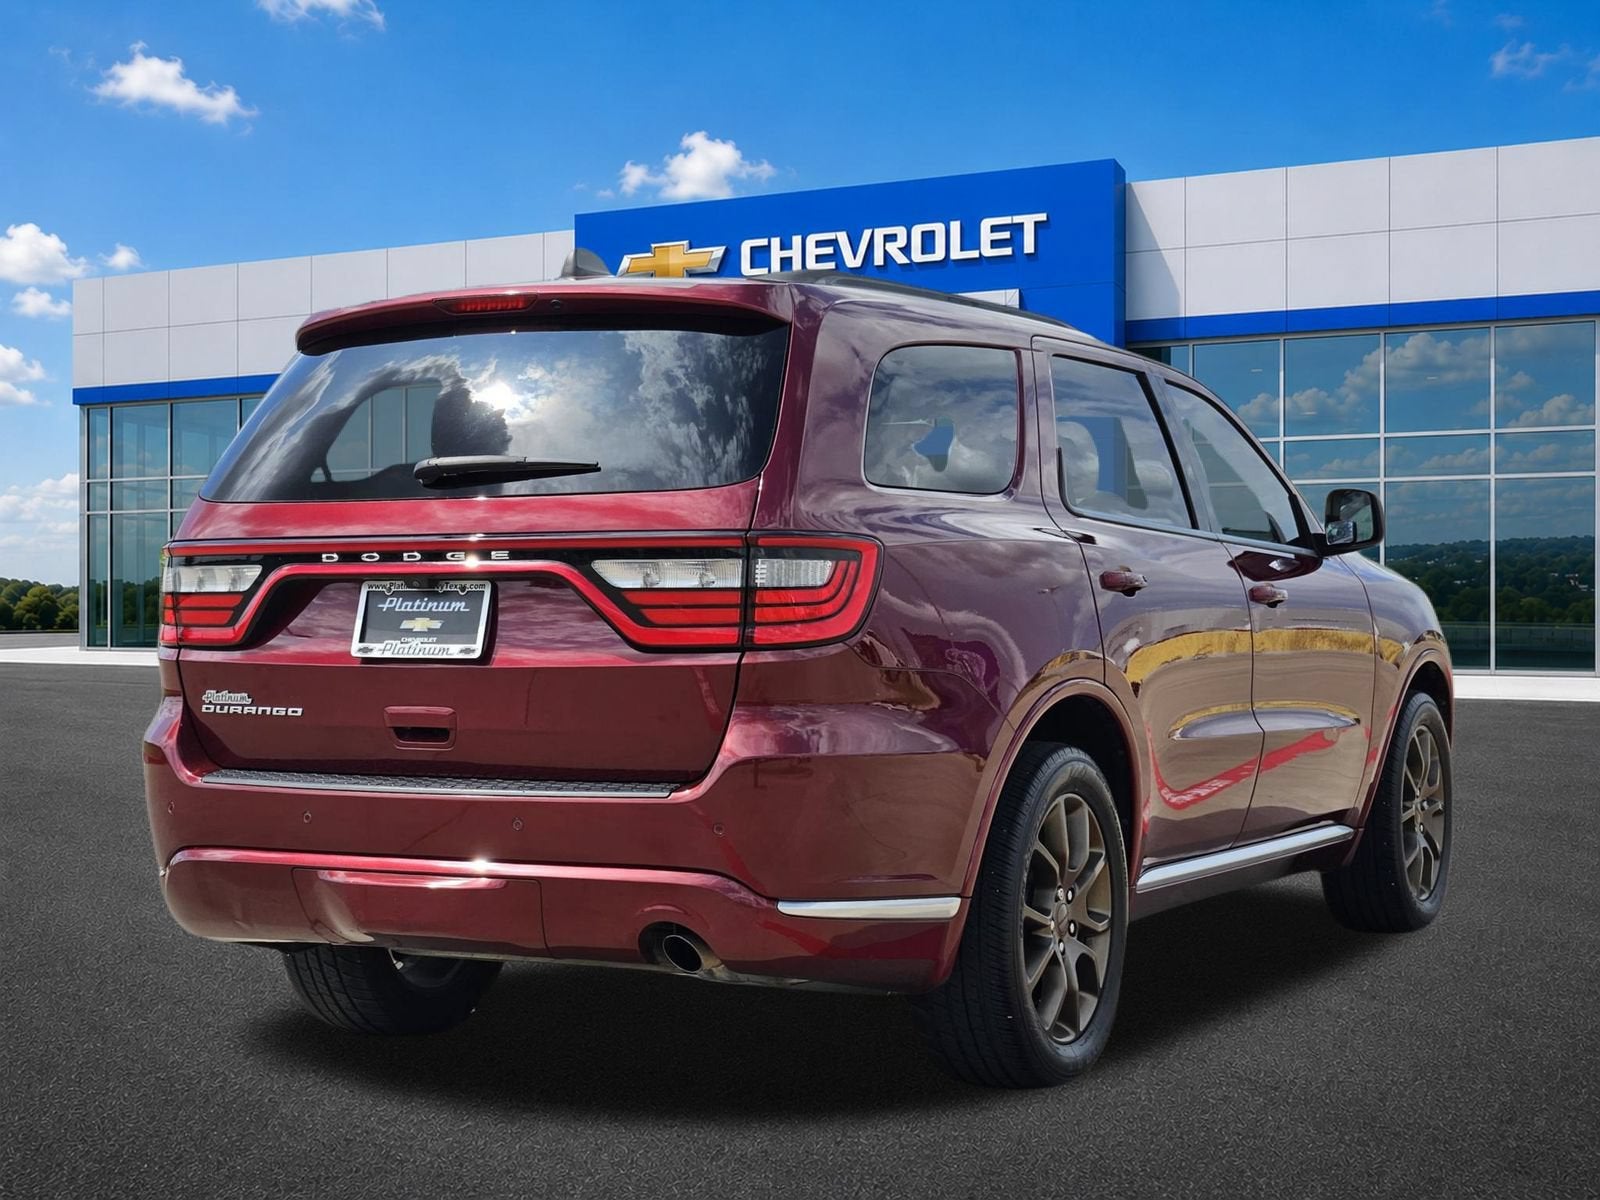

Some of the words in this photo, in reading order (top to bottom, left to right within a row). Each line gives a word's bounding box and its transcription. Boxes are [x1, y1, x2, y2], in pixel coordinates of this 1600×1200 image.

[740, 212, 1048, 277] CHEVROLET
[321, 551, 510, 562] DODGE
[378, 597, 470, 611] Platinum
[378, 642, 455, 656] Platinum
[202, 690, 252, 704] Platinum
[202, 704, 303, 716] DURANGO
